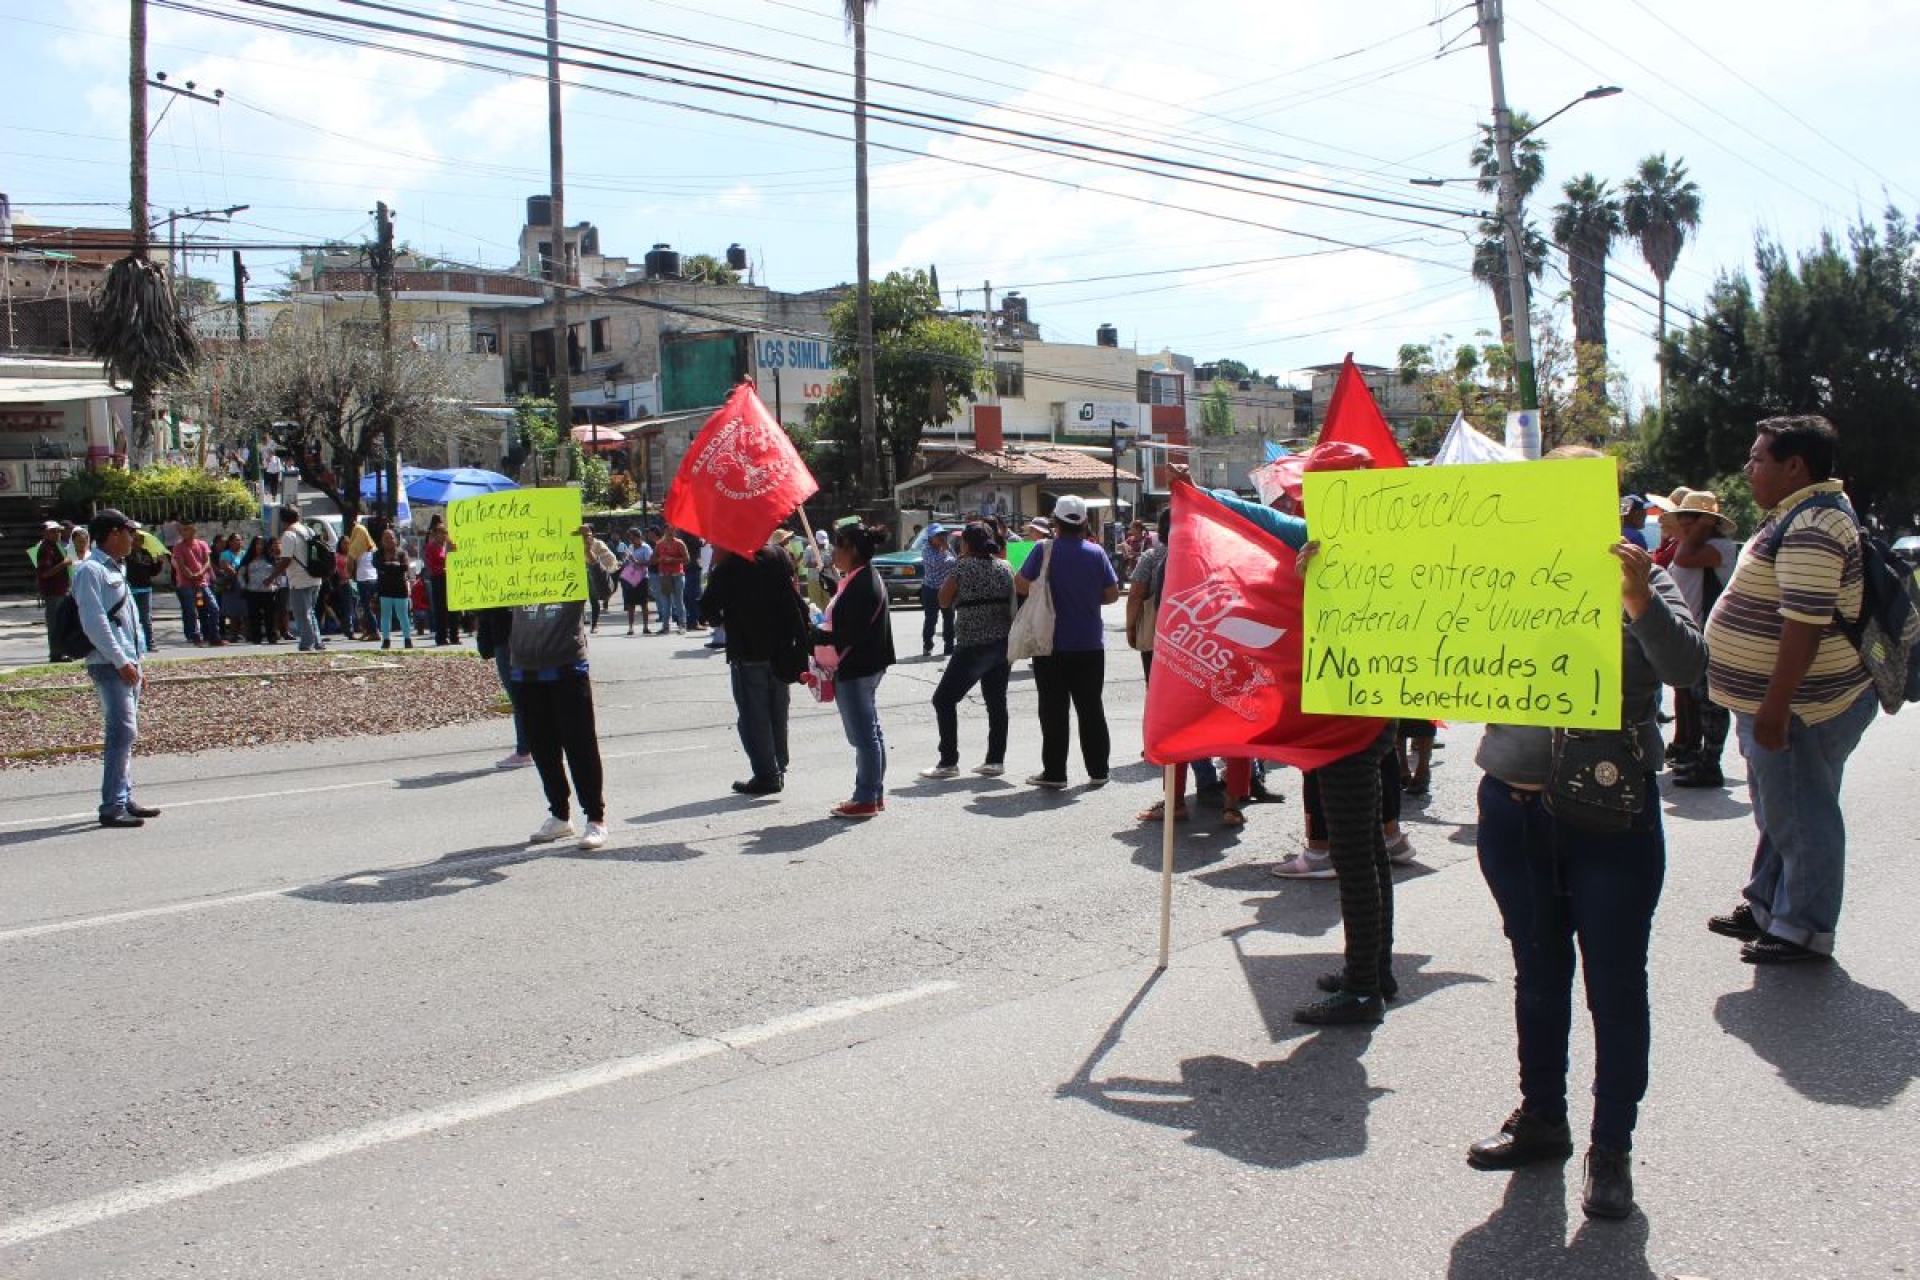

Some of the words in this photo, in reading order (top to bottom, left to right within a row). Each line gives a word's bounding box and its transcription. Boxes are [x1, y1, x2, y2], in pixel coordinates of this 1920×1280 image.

[757, 339, 784, 368] LOS
[537, 516, 562, 539] del
[1320, 476, 1537, 540] Antorcha
[505, 544, 523, 566] de
[506, 570, 520, 587] al
[525, 566, 577, 586] fraude
[1316, 544, 1395, 605] Exige
[1410, 544, 1516, 611] entrega
[1530, 549, 1572, 591] de
[1316, 600, 1426, 634] material
[1436, 592, 1470, 633] de
[1169, 622, 1235, 670] años
[1369, 655, 1419, 674] mas
[1427, 635, 1537, 678] fraudes
[1551, 653, 1570, 677] a
[1348, 681, 1384, 707] los
[1399, 677, 1574, 715] beneficiados
